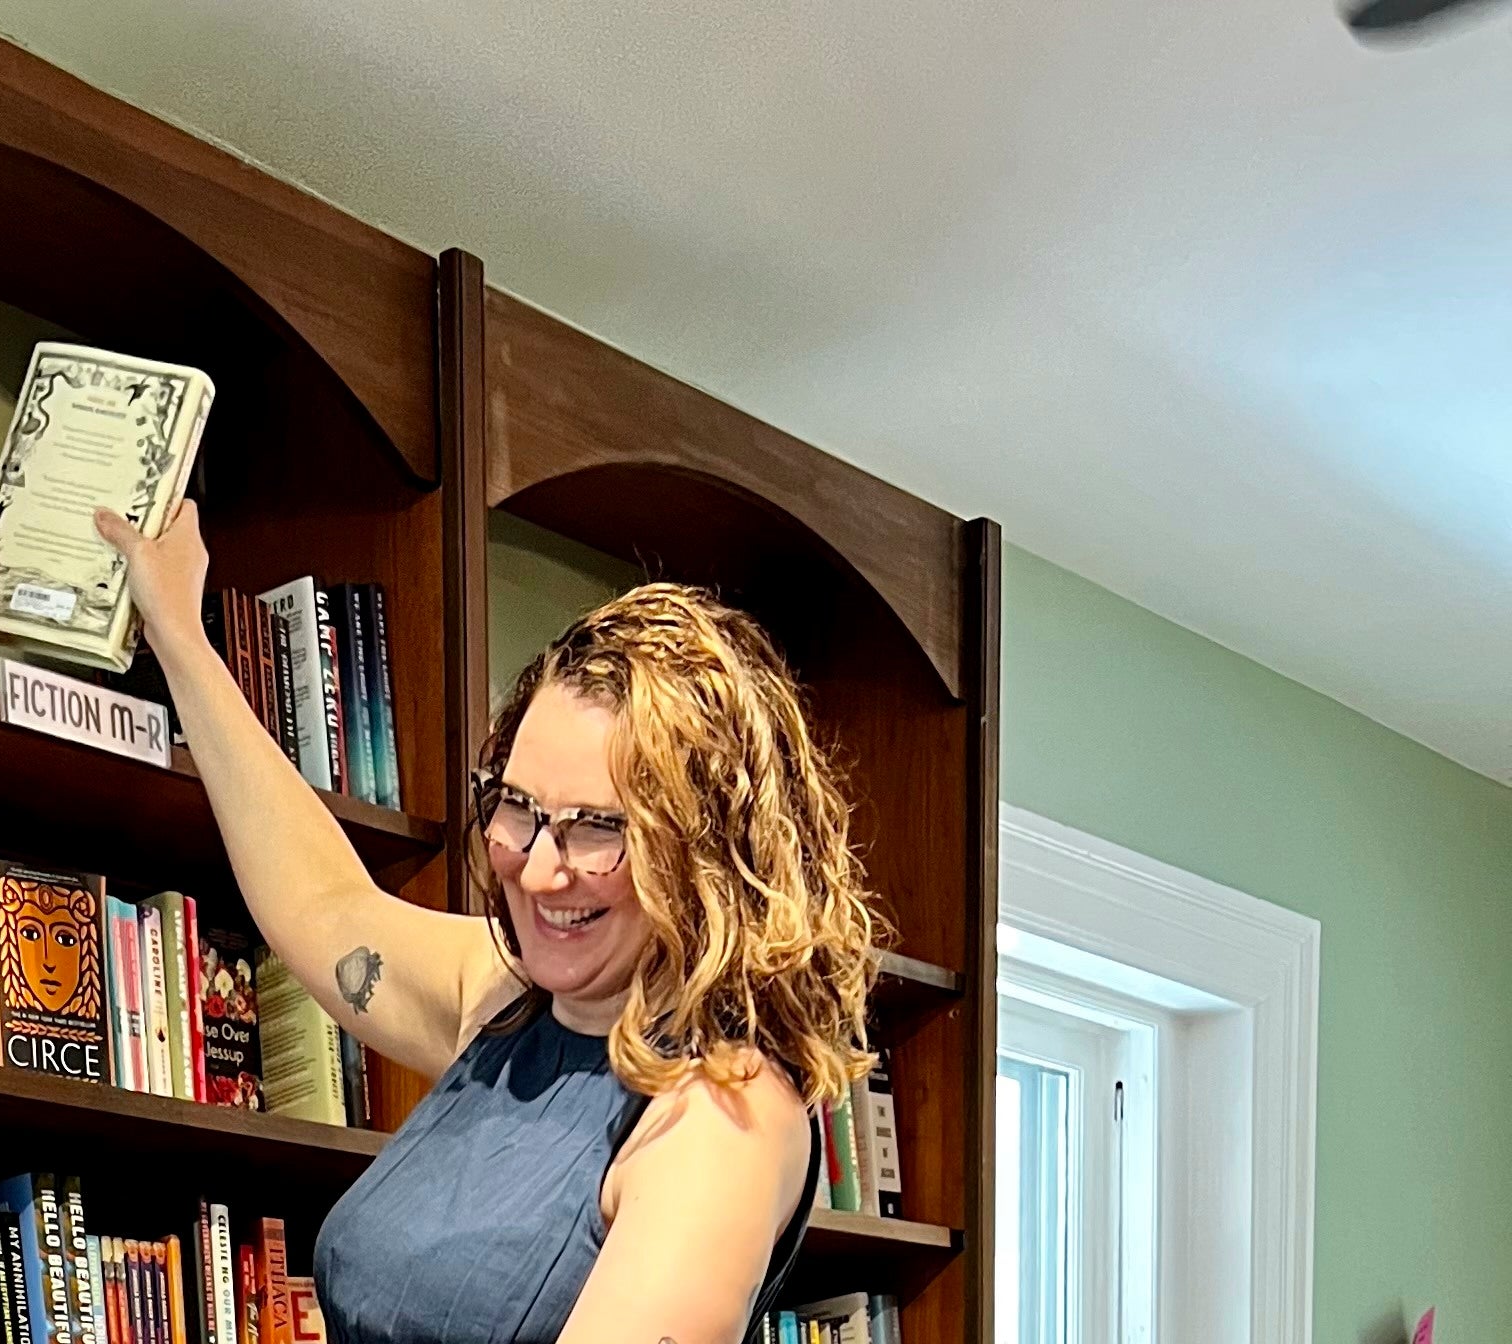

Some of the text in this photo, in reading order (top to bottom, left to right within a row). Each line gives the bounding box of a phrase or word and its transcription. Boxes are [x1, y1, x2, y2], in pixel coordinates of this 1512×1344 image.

[8, 672, 164, 753] FICTION M-R
[7, 1034, 101, 1078] CIRCE
[221, 1023, 250, 1044] Over
[41, 1188, 61, 1250] HELLO
[68, 1192, 86, 1251] HELLO
[218, 1214, 228, 1262] CELESTE
[223, 1288, 232, 1315] OUR
